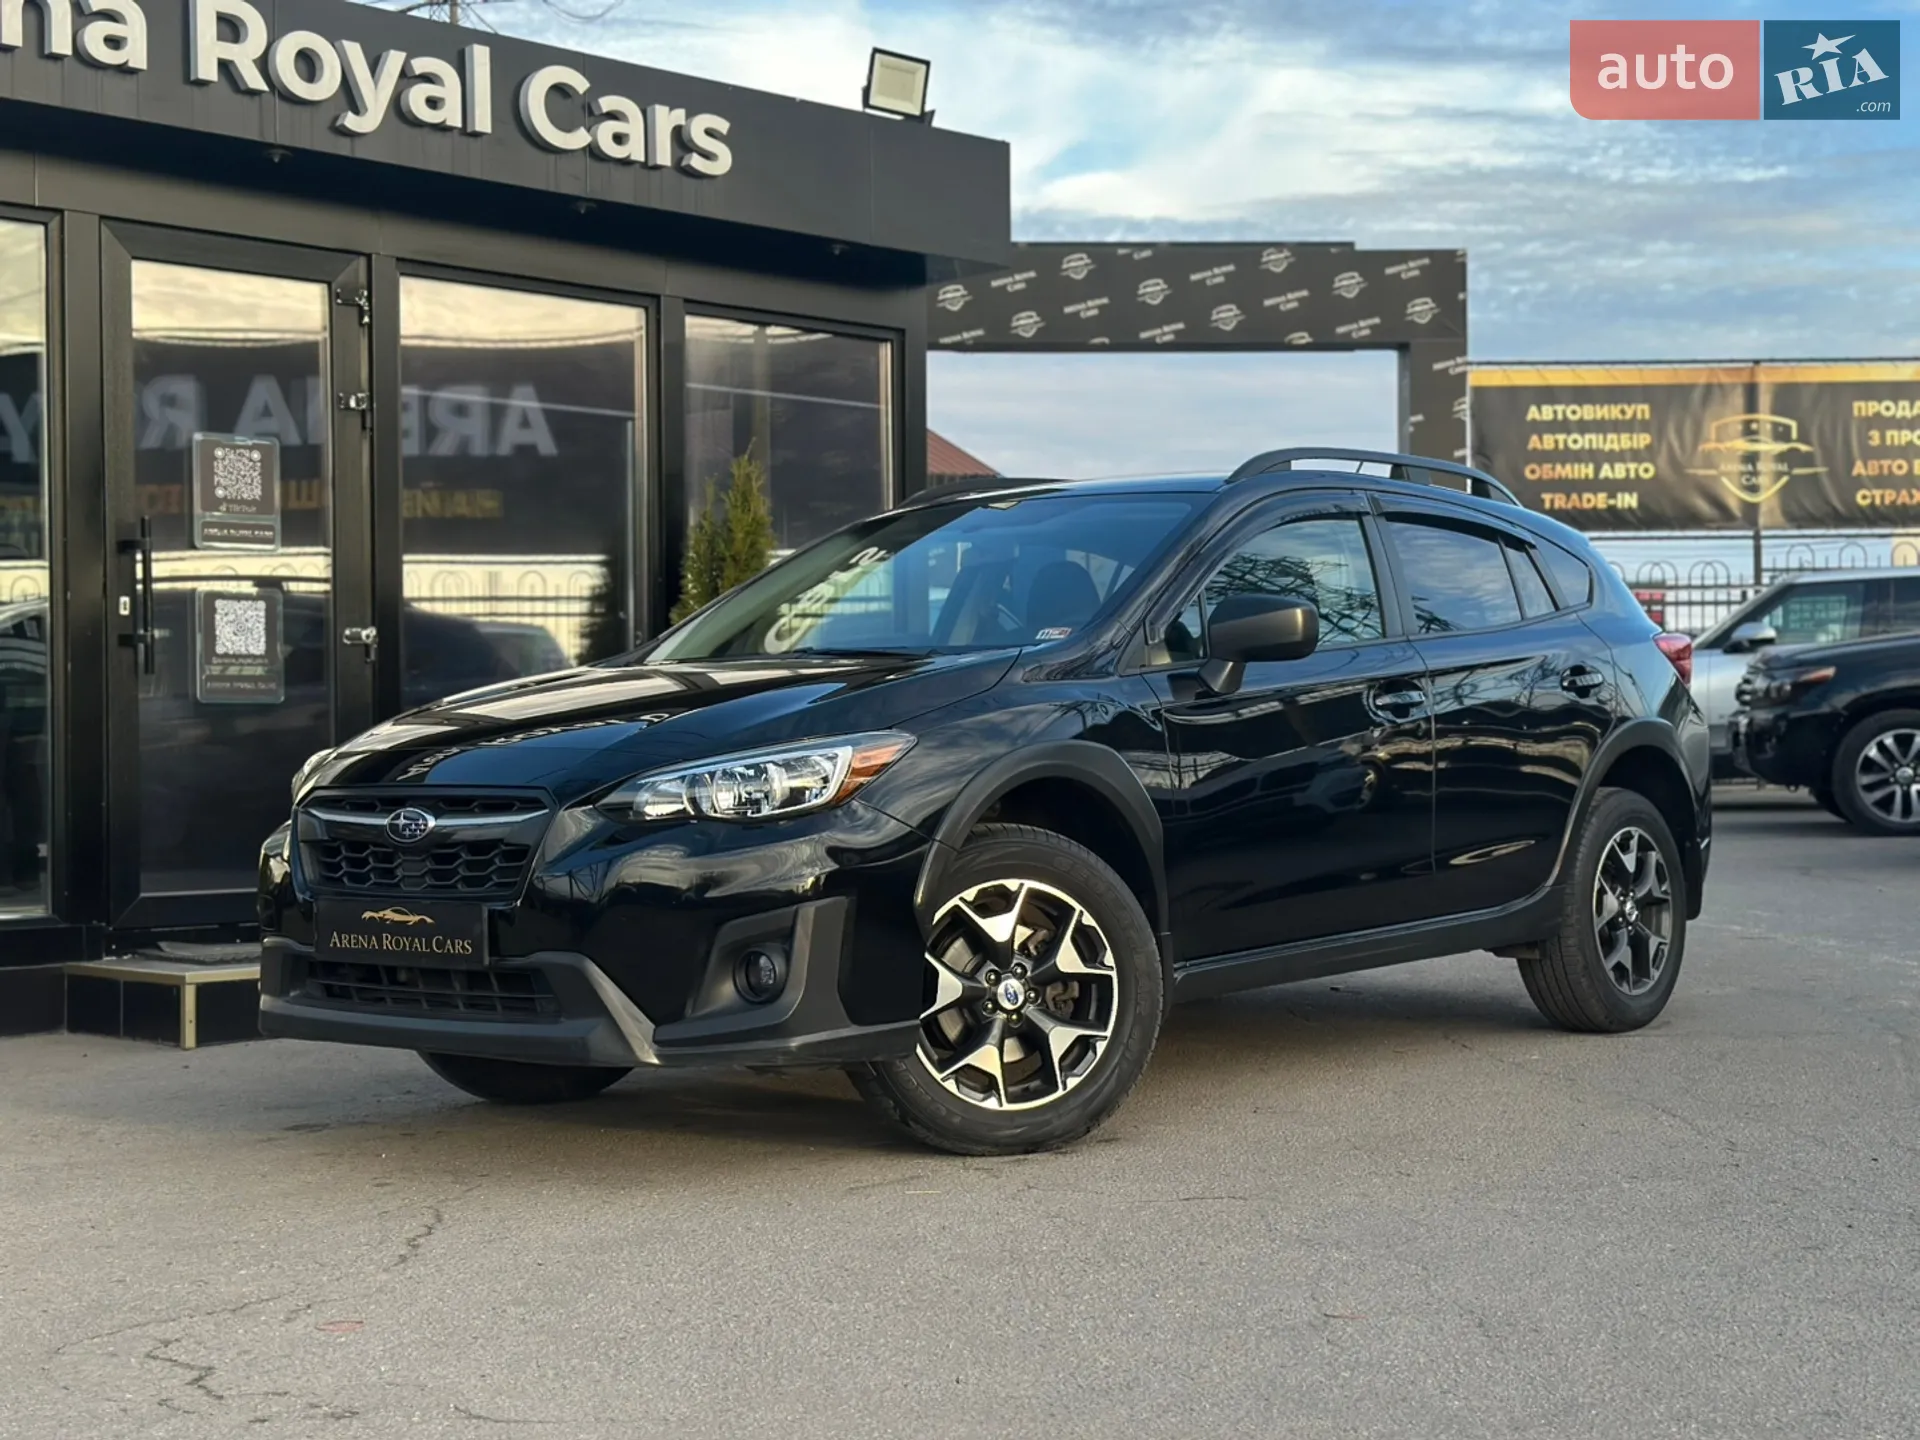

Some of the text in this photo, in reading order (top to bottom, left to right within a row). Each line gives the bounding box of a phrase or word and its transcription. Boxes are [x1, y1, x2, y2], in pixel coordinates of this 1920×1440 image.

[189, 0, 492, 136] Royal
[519, 65, 732, 176] Cars
[1526, 403, 1650, 421] АВТОВИКУП
[1527, 433, 1653, 452] АВТОПІДБІР
[1524, 461, 1656, 480] ОБМІН АВТО
[1851, 459, 1908, 476] АВТО
[1541, 492, 1638, 510] TRADE-IN
[330, 931, 472, 954] ARENA ROYAL CARS
